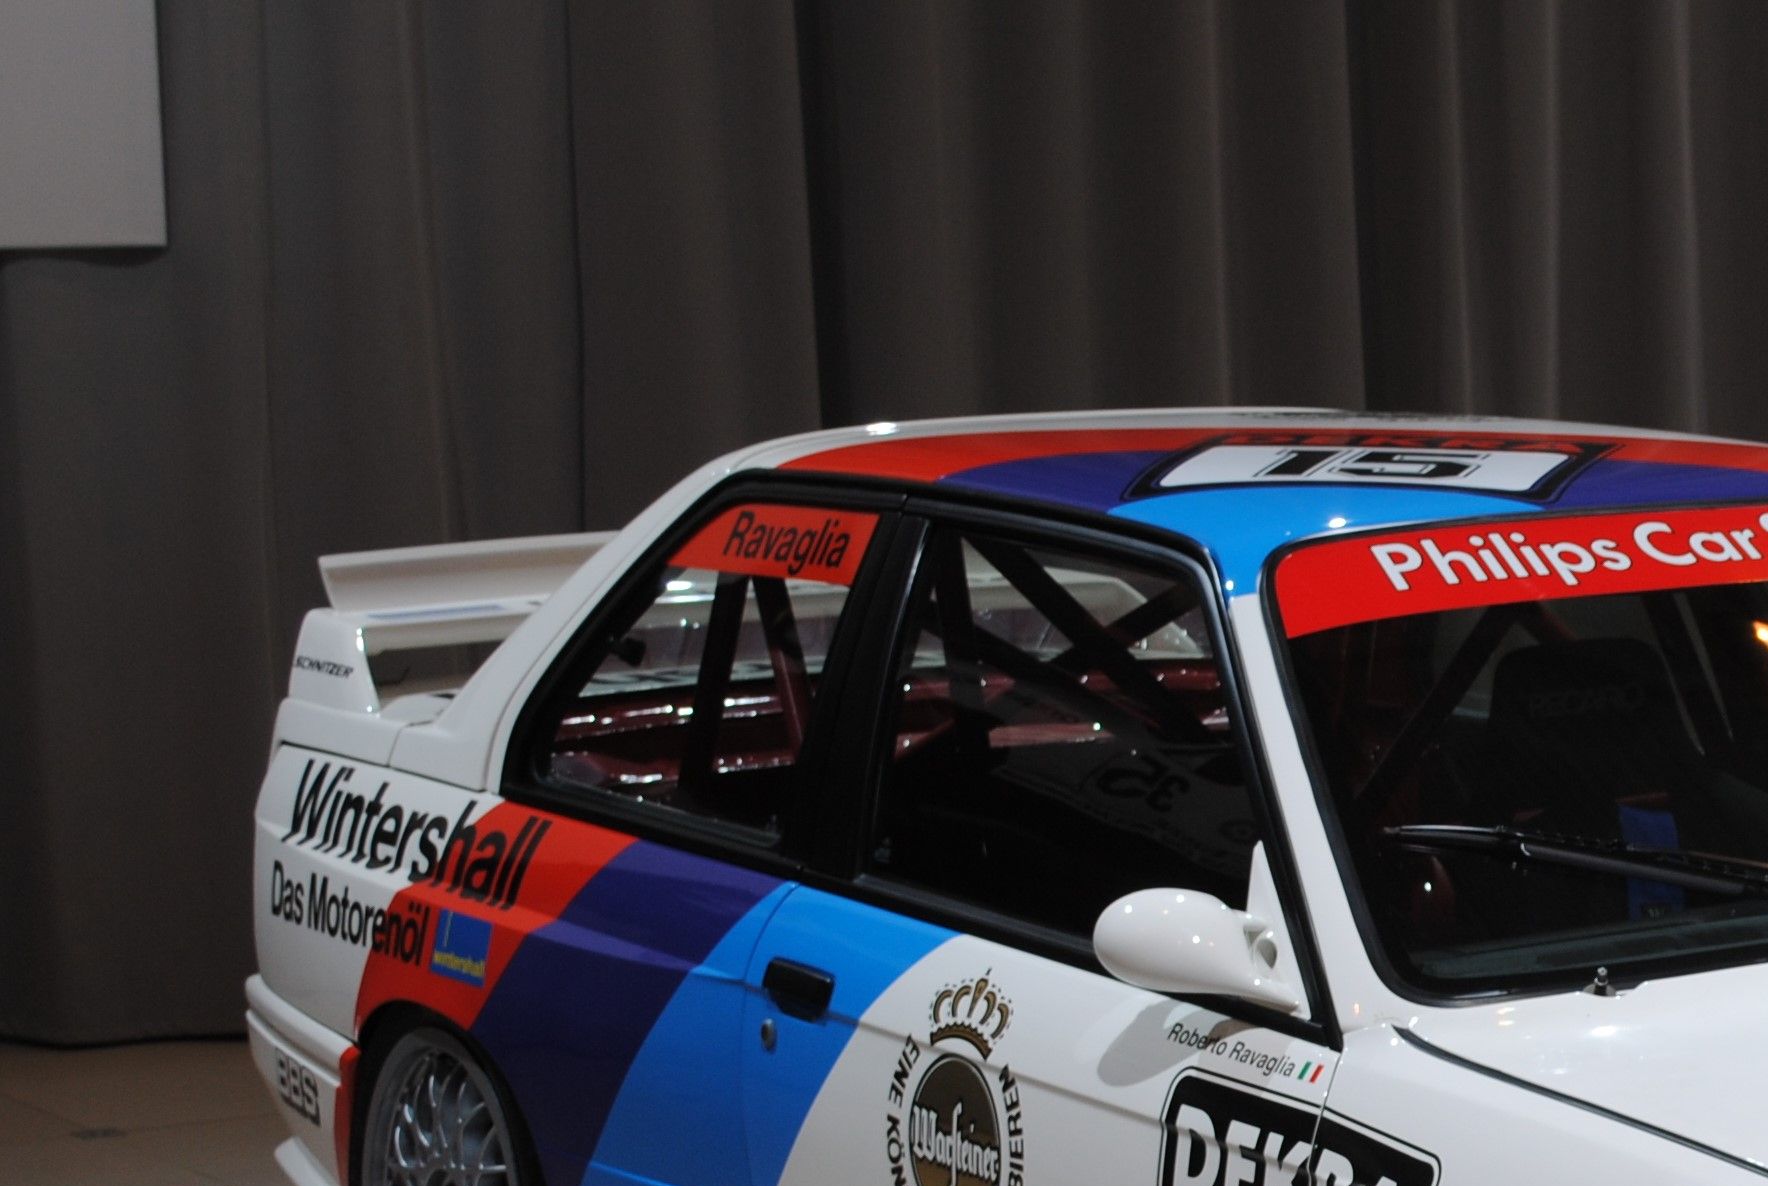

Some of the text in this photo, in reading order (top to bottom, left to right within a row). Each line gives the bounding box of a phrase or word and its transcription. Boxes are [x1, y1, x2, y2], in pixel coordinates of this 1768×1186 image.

[1253, 449, 1491, 479] 15
[723, 511, 849, 574] Ravaglia
[1370, 530, 1632, 592] Philips
[1632, 521, 1761, 568] Car
[281, 759, 552, 910] Wintershall
[271, 860, 431, 966] Das Motorenöl
[889, 1034, 920, 1109] EINE
[1167, 1022, 1296, 1077] Roberto Ravaglia
